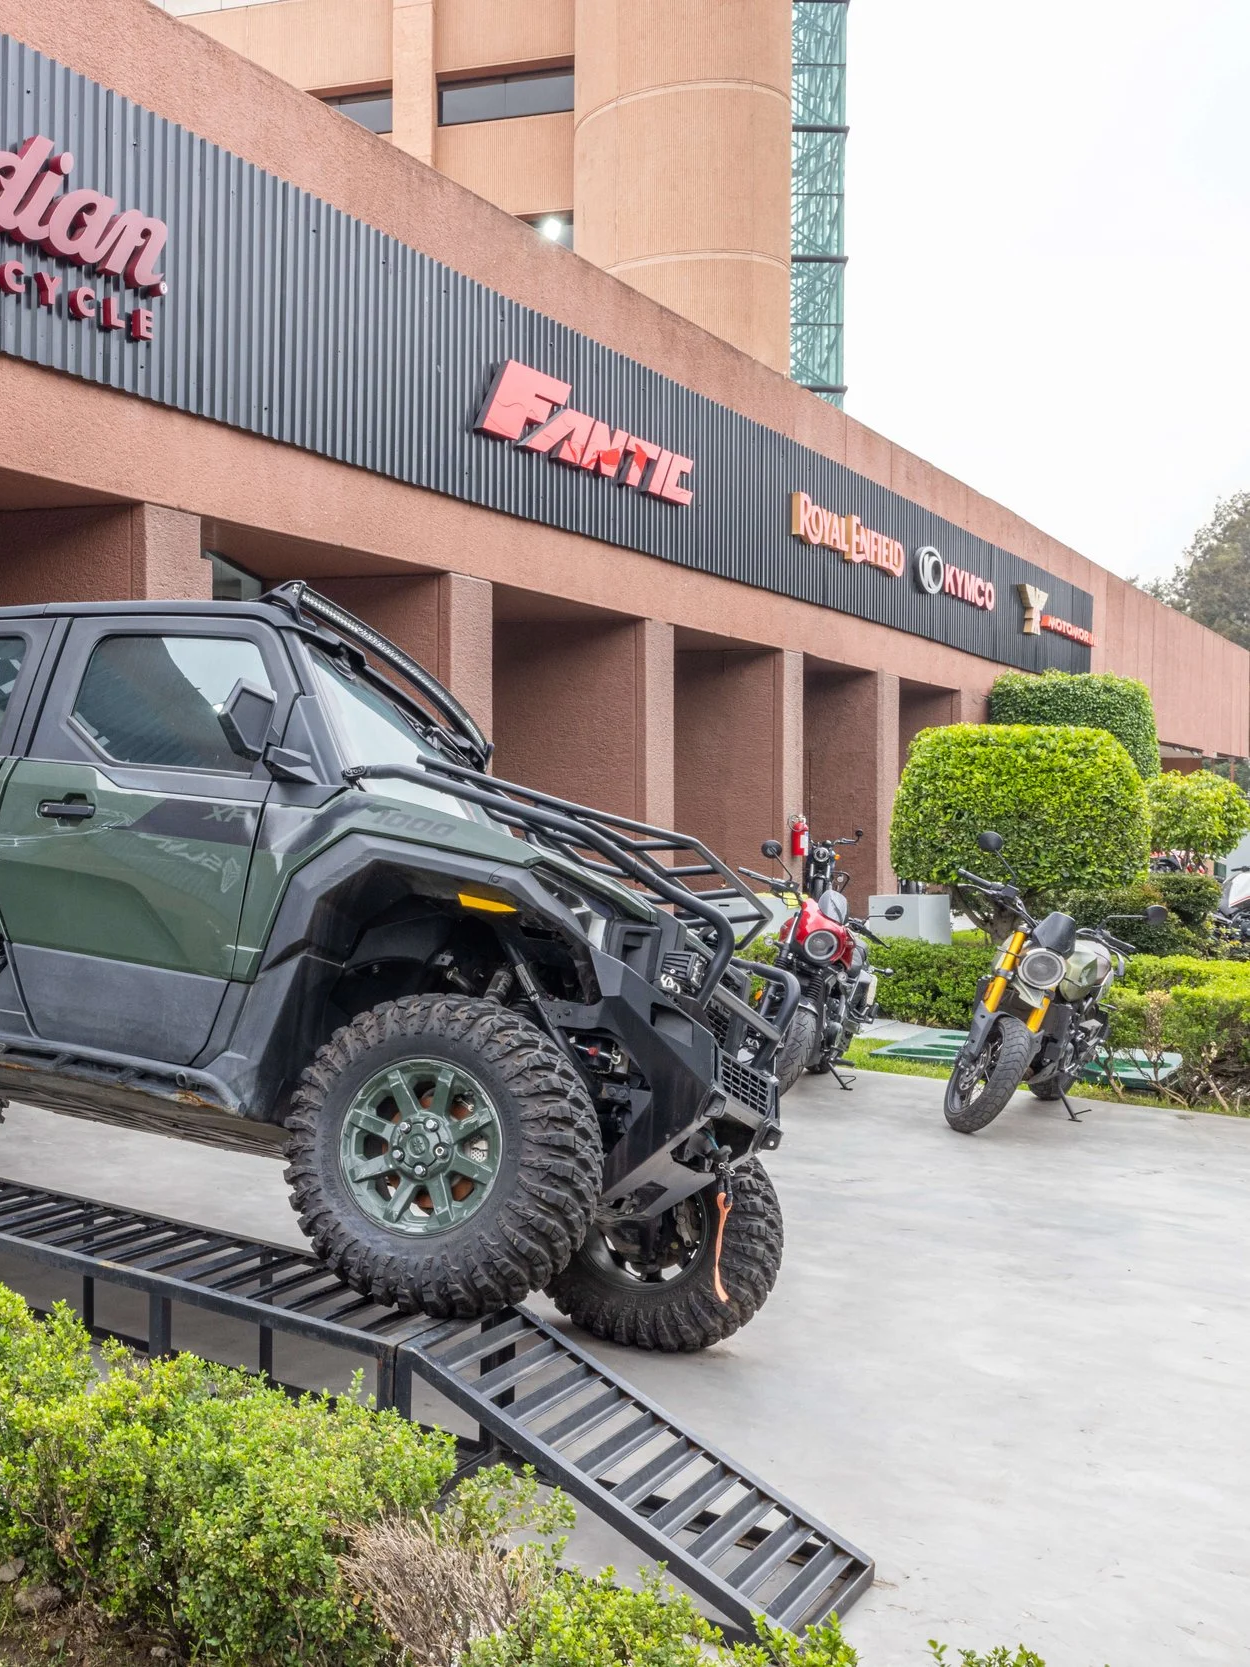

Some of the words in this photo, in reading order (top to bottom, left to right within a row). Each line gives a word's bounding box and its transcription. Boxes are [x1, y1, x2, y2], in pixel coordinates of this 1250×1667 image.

[474, 359, 694, 506] FANTIC
[791, 492, 850, 552] ROYAL
[843, 514, 905, 578] ENFIELD
[944, 563, 996, 611] KYMCO
